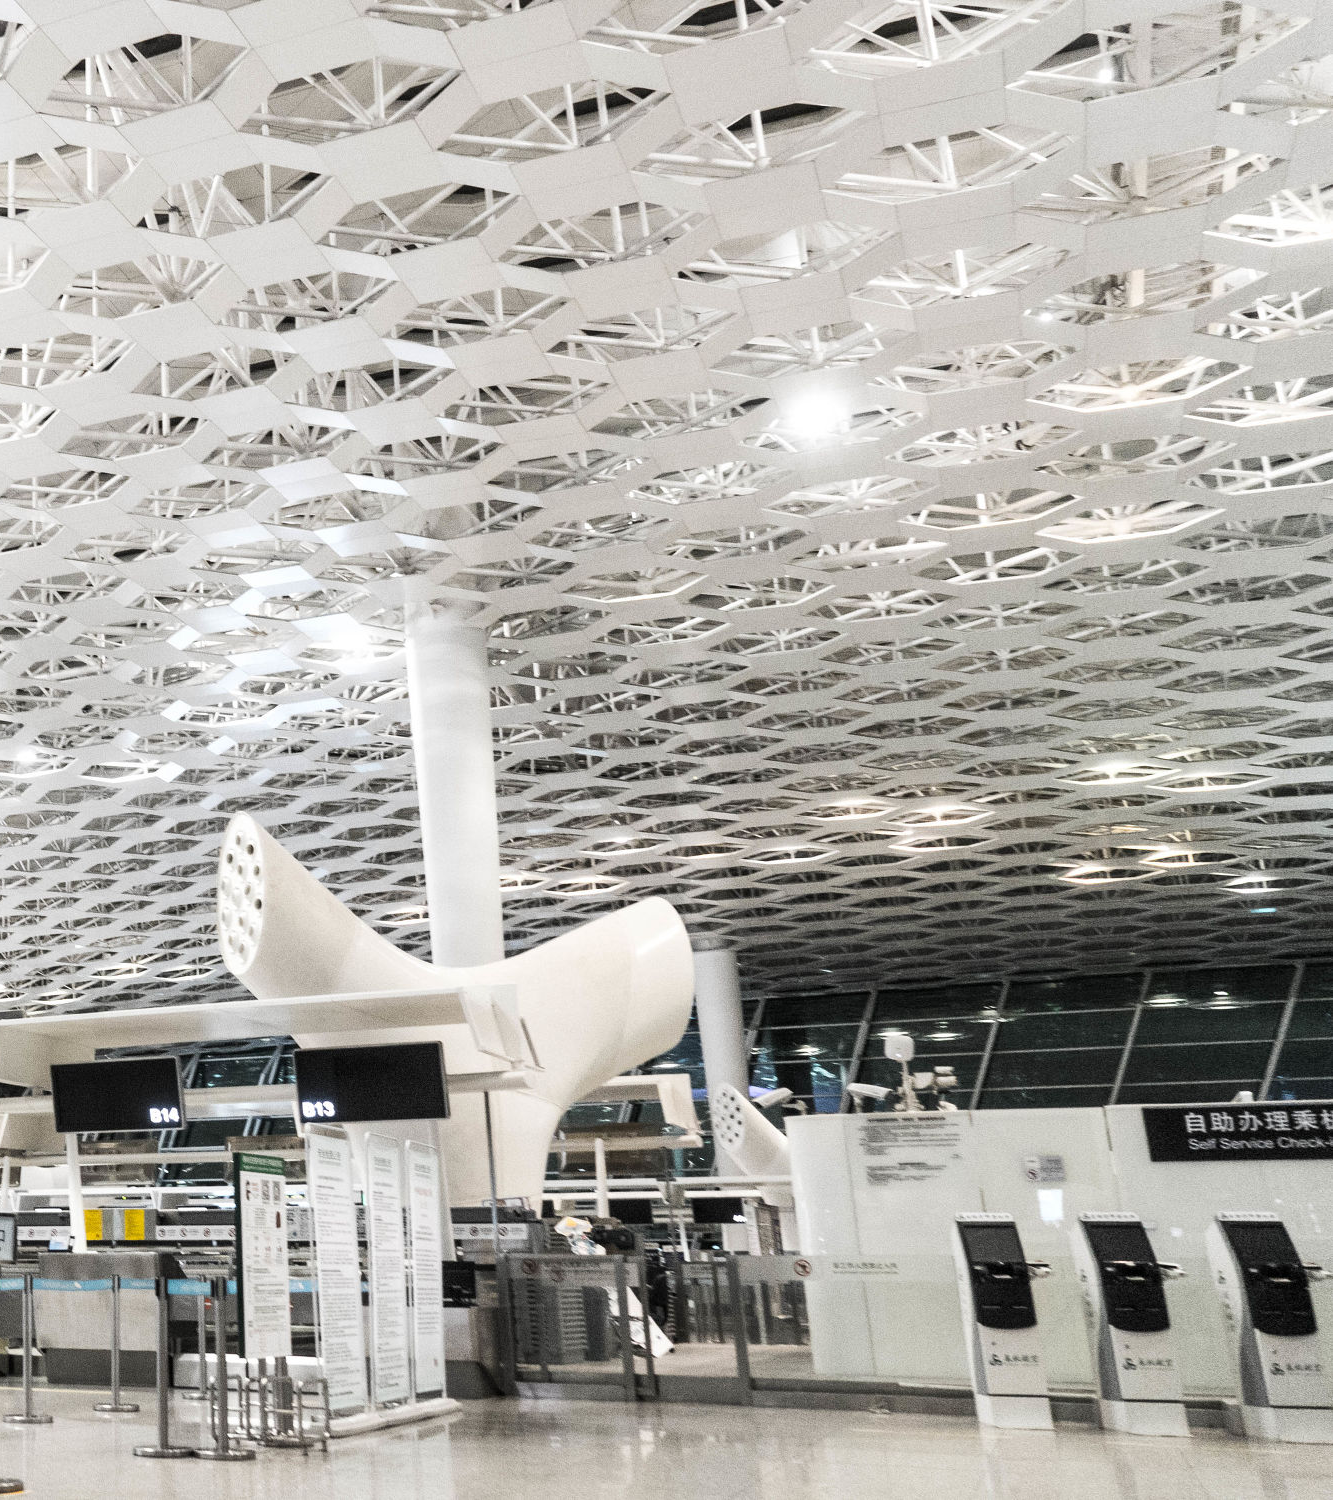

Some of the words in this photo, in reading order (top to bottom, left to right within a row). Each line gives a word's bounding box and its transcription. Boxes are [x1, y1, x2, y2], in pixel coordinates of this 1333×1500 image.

[149, 1107, 180, 1123] B14
[301, 1100, 336, 1118] B13
[1188, 1138, 1216, 1150] Self
[1219, 1137, 1274, 1149] Service
